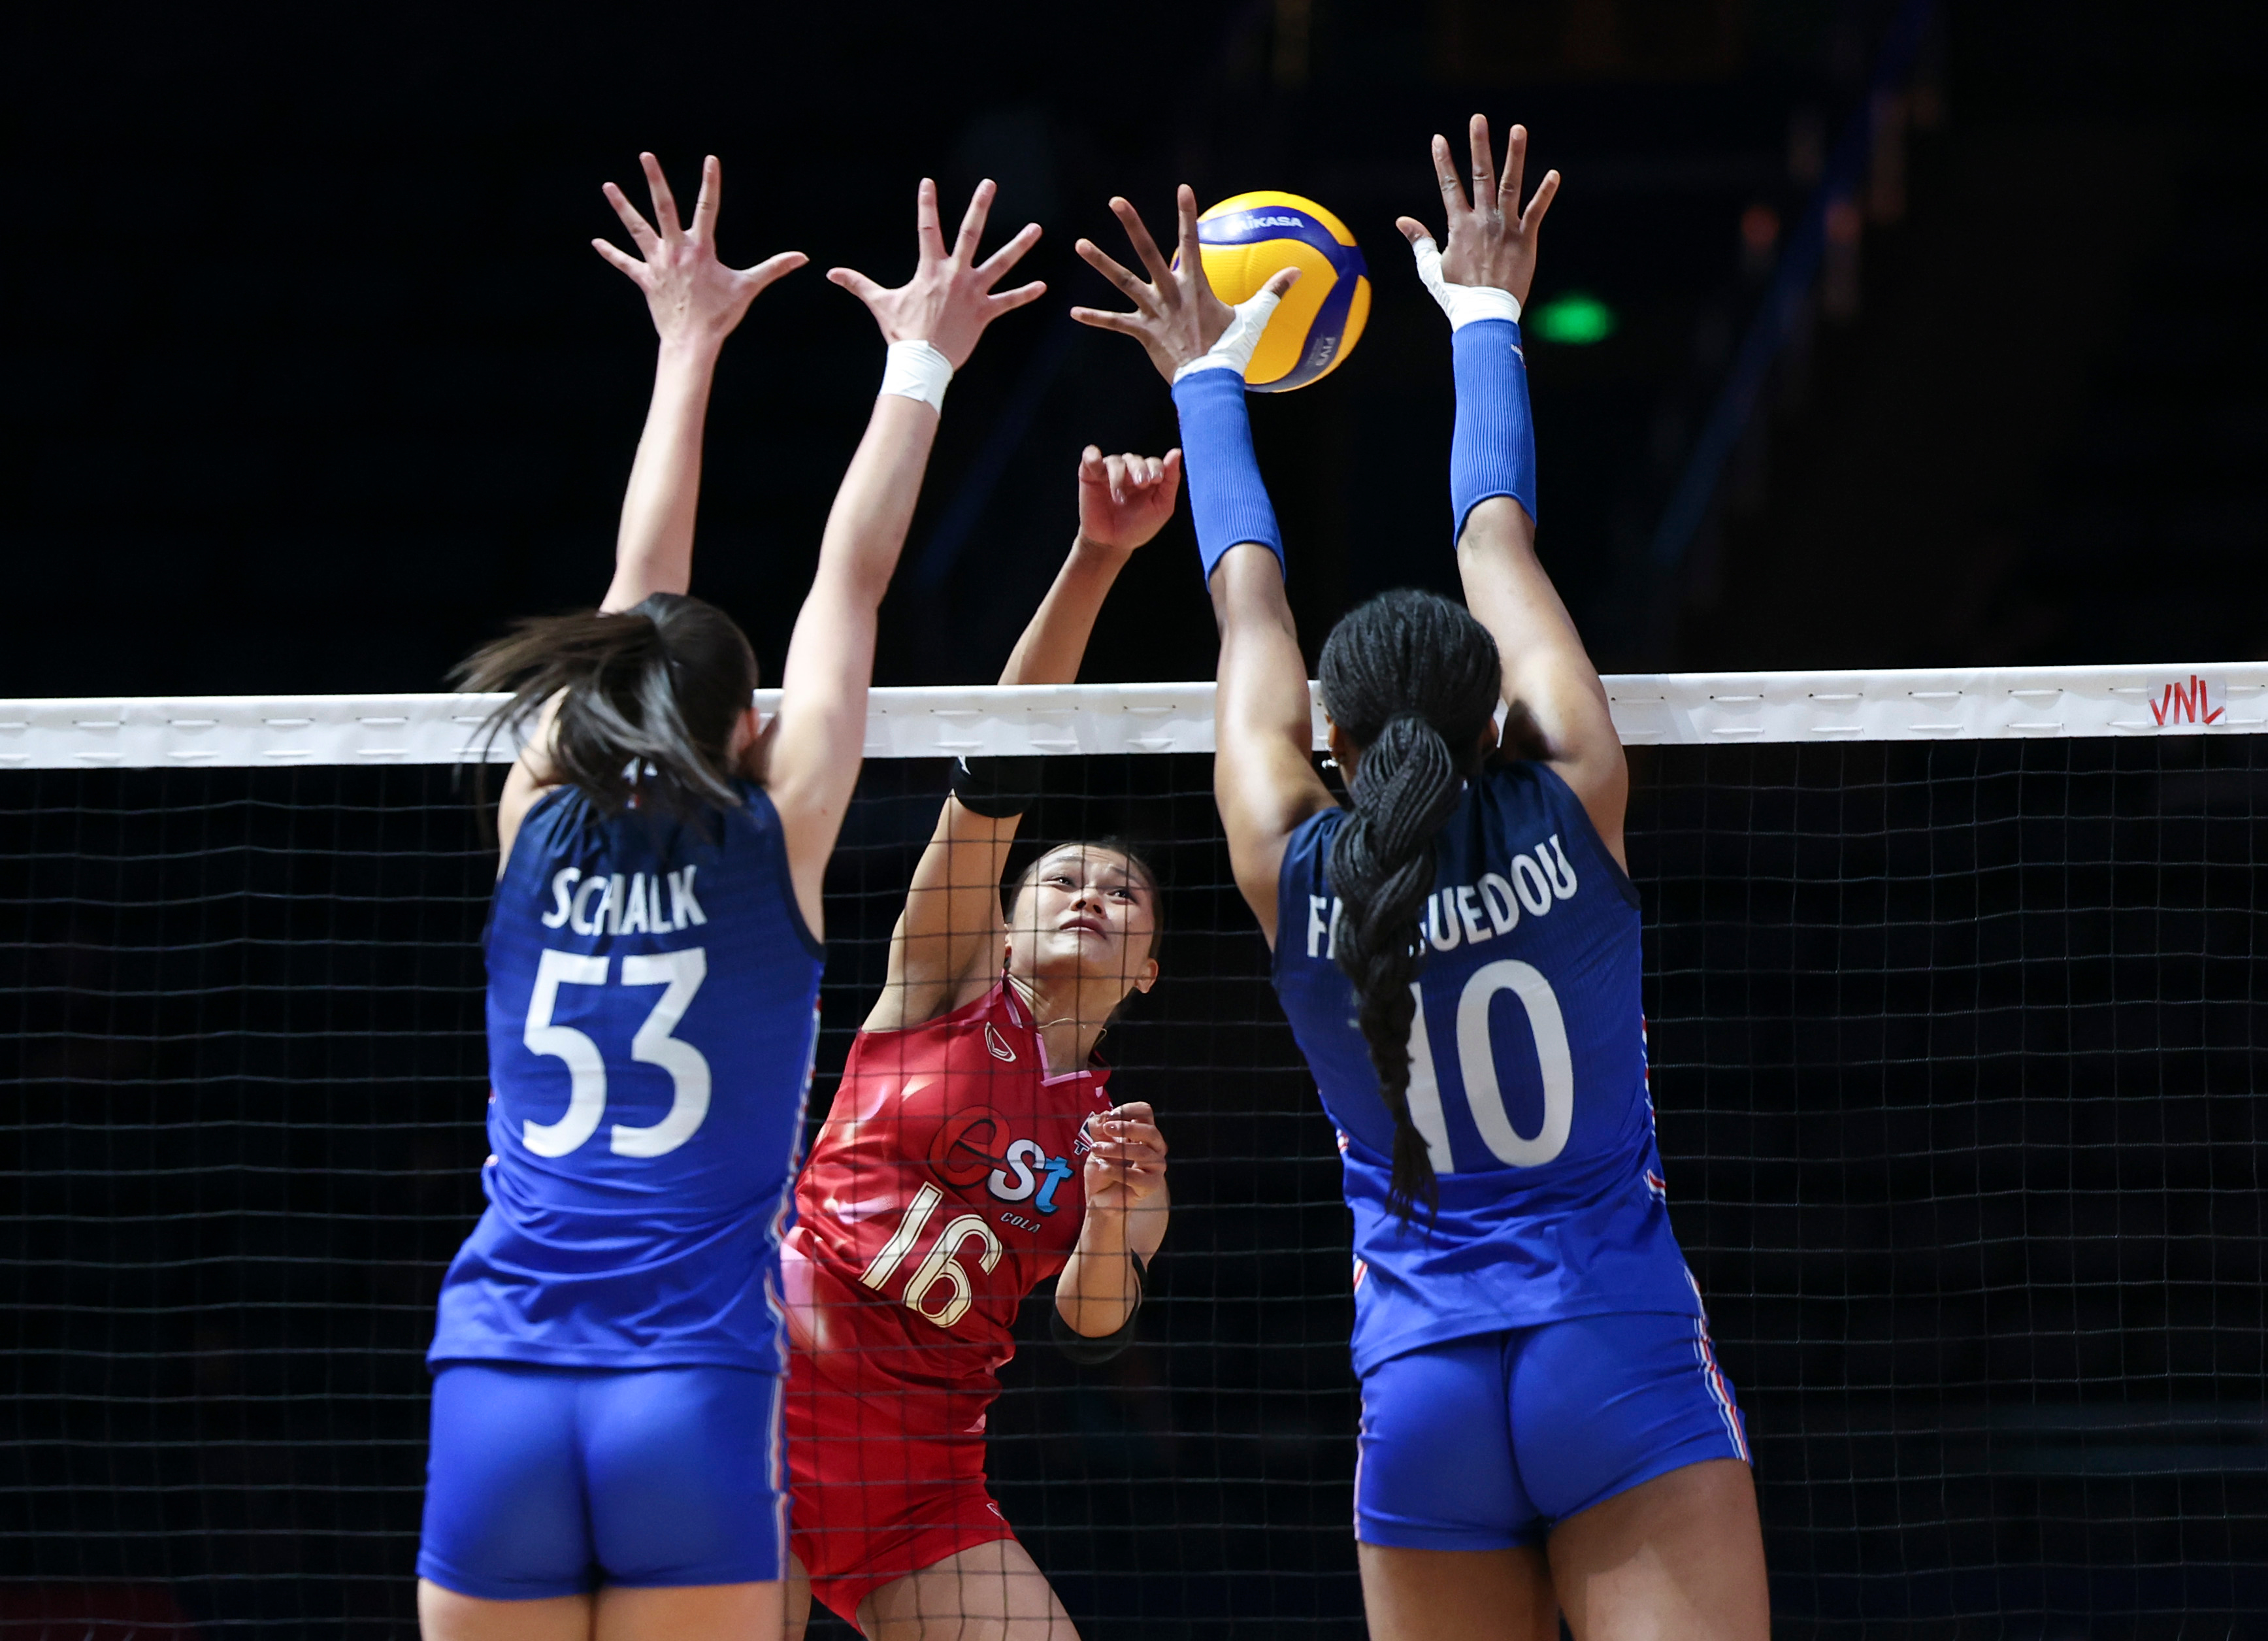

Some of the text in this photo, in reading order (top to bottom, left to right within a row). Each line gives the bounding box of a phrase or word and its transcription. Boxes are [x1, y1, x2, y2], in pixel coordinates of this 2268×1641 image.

[2148, 674, 2226, 726] VNL
[541, 864, 708, 936] SCHALK
[522, 946, 713, 1158] 53
[1405, 959, 1573, 1174] 10
[928, 1104, 1075, 1216] est
[858, 1181, 1002, 1328] 16
[1000, 1212, 1042, 1233] COLA
